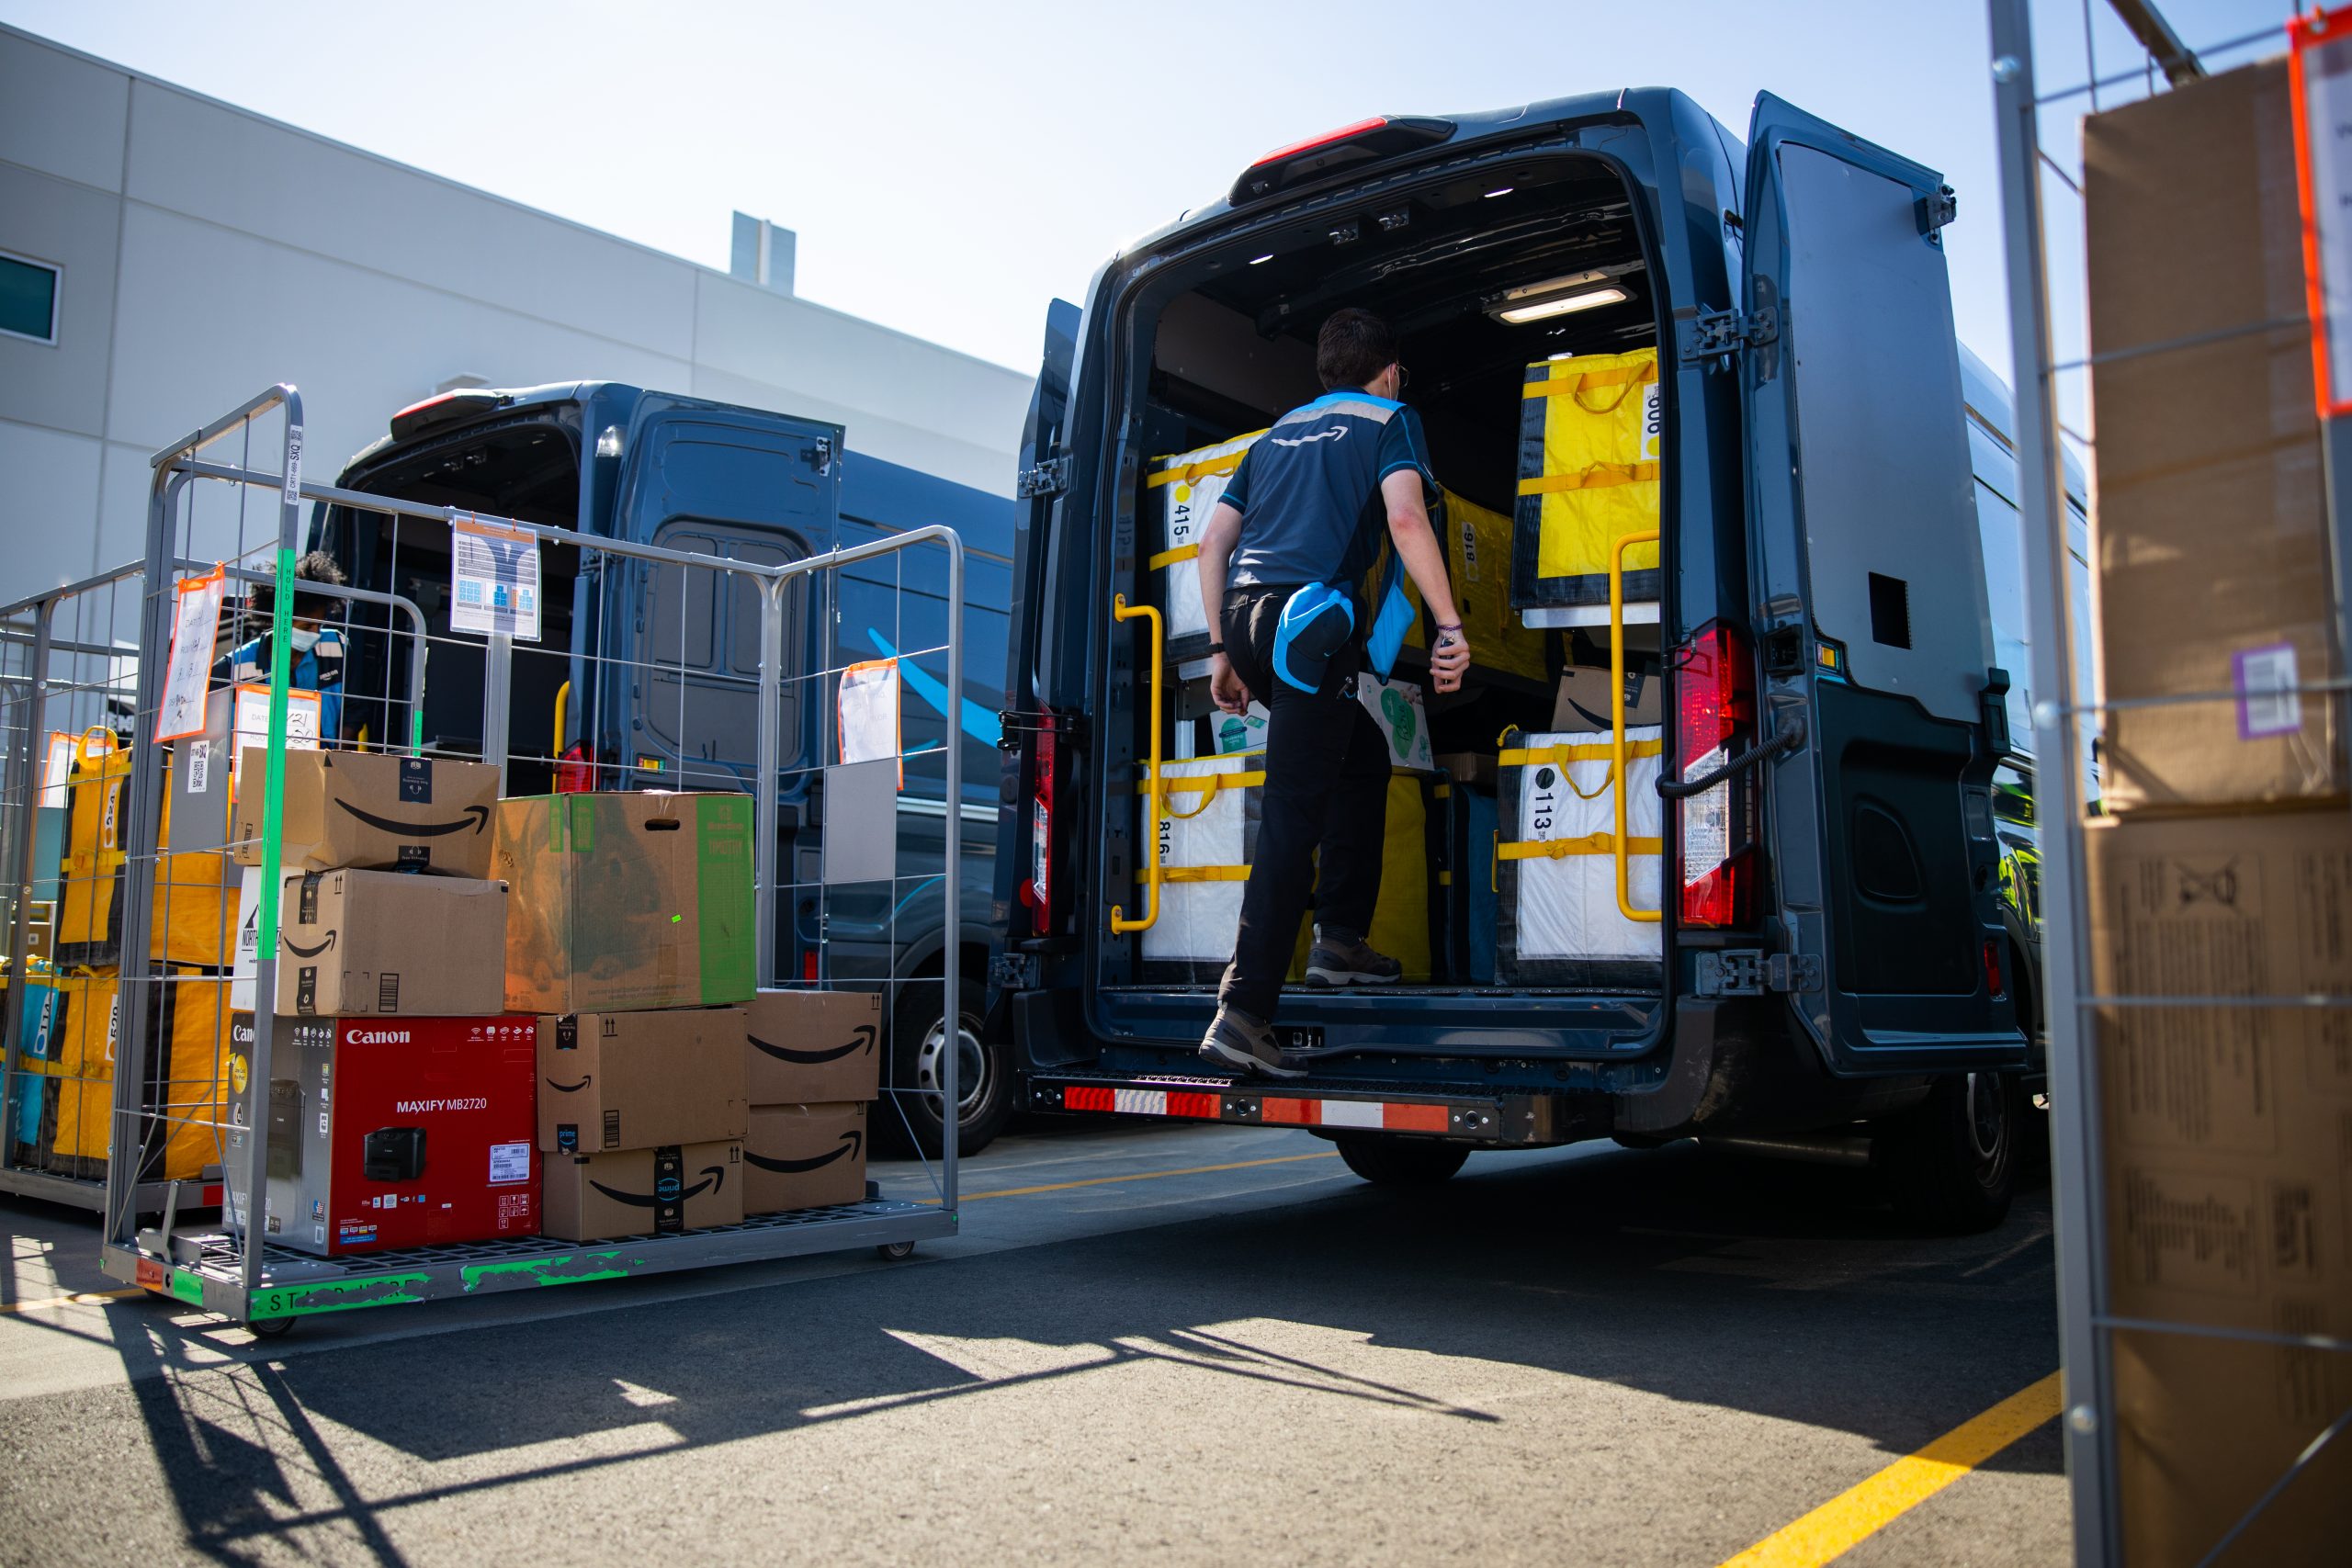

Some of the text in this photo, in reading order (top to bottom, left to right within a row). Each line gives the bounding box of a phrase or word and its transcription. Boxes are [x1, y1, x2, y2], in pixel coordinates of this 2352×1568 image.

[1173, 505, 1190, 536] 415
[1464, 533, 1475, 561] 816
[107, 795, 116, 826] 224
[1534, 793, 1554, 829] 113
[1159, 821, 1170, 854] 816
[40, 1002, 51, 1032] 114
[233, 1024, 254, 1042] Can
[346, 1030, 410, 1044] Canon
[397, 1098, 487, 1115] MAXIFY MB2720
[559, 1130, 575, 1138] prime
[658, 1182, 679, 1192] prime
